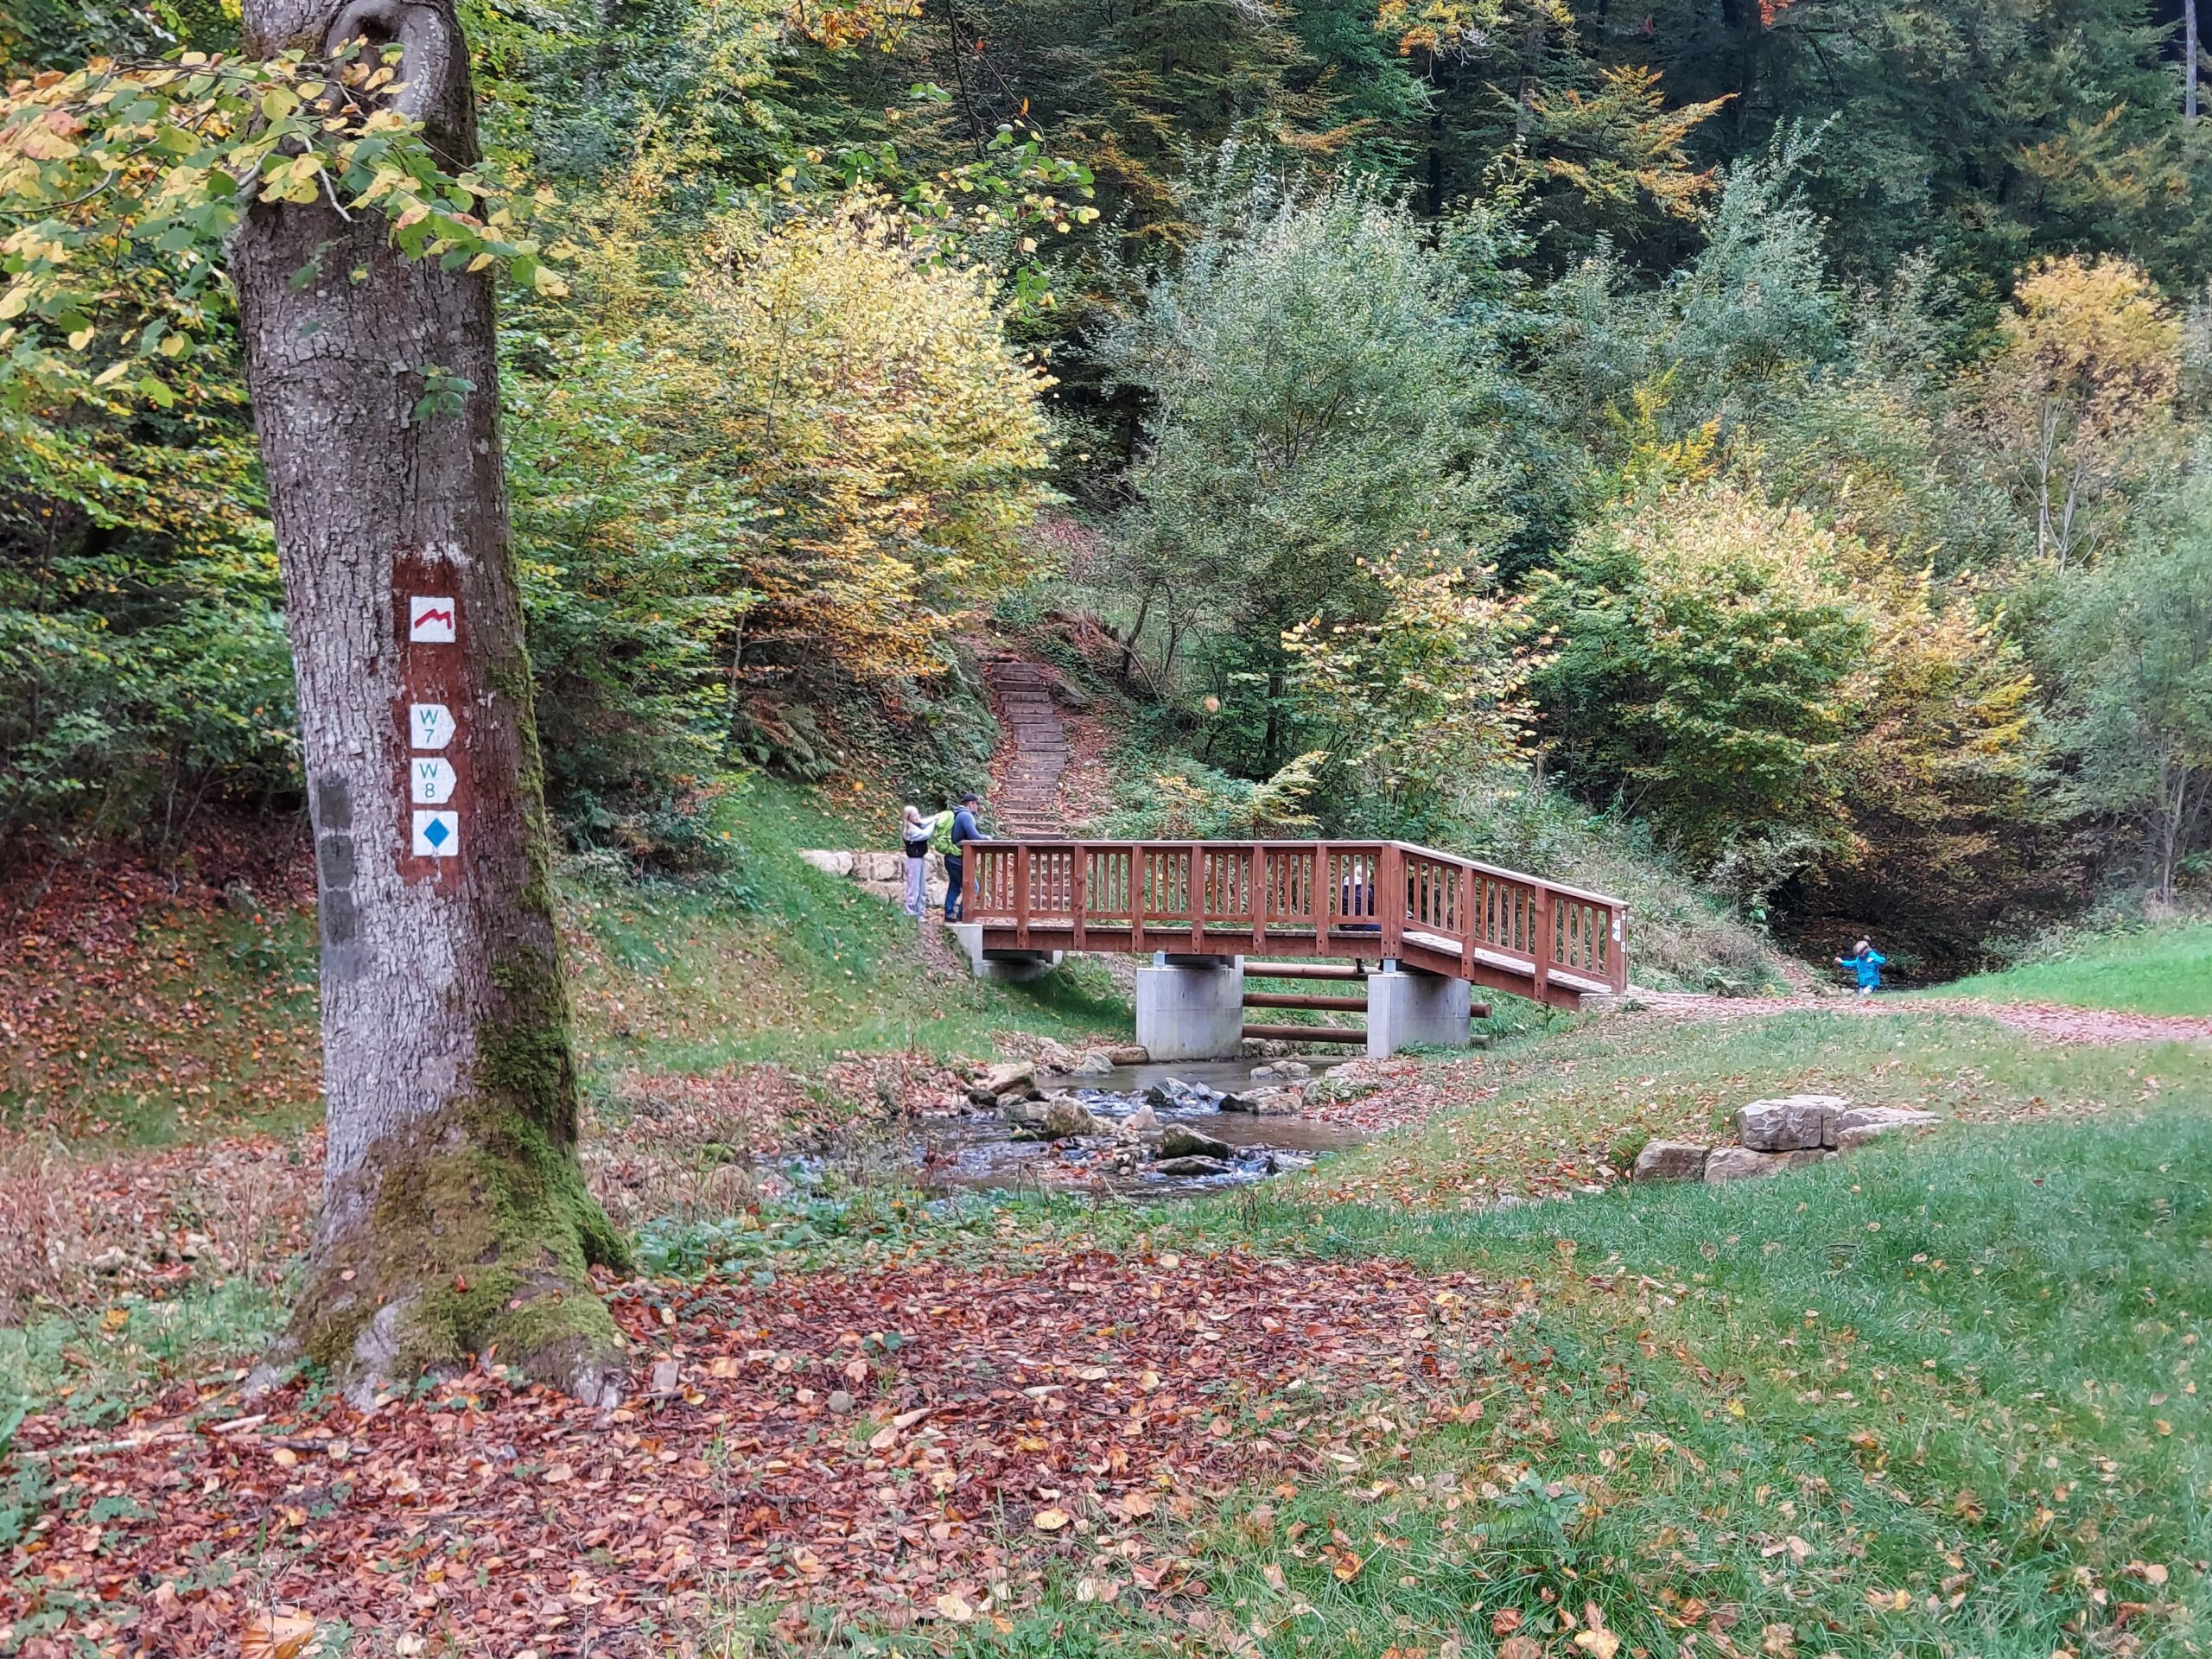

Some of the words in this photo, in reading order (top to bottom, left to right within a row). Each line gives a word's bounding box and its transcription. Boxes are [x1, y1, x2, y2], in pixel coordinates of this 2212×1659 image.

[420, 709, 438, 725] W
[424, 728, 435, 743] 7
[420, 763, 438, 779] W
[424, 782, 435, 798] 8
